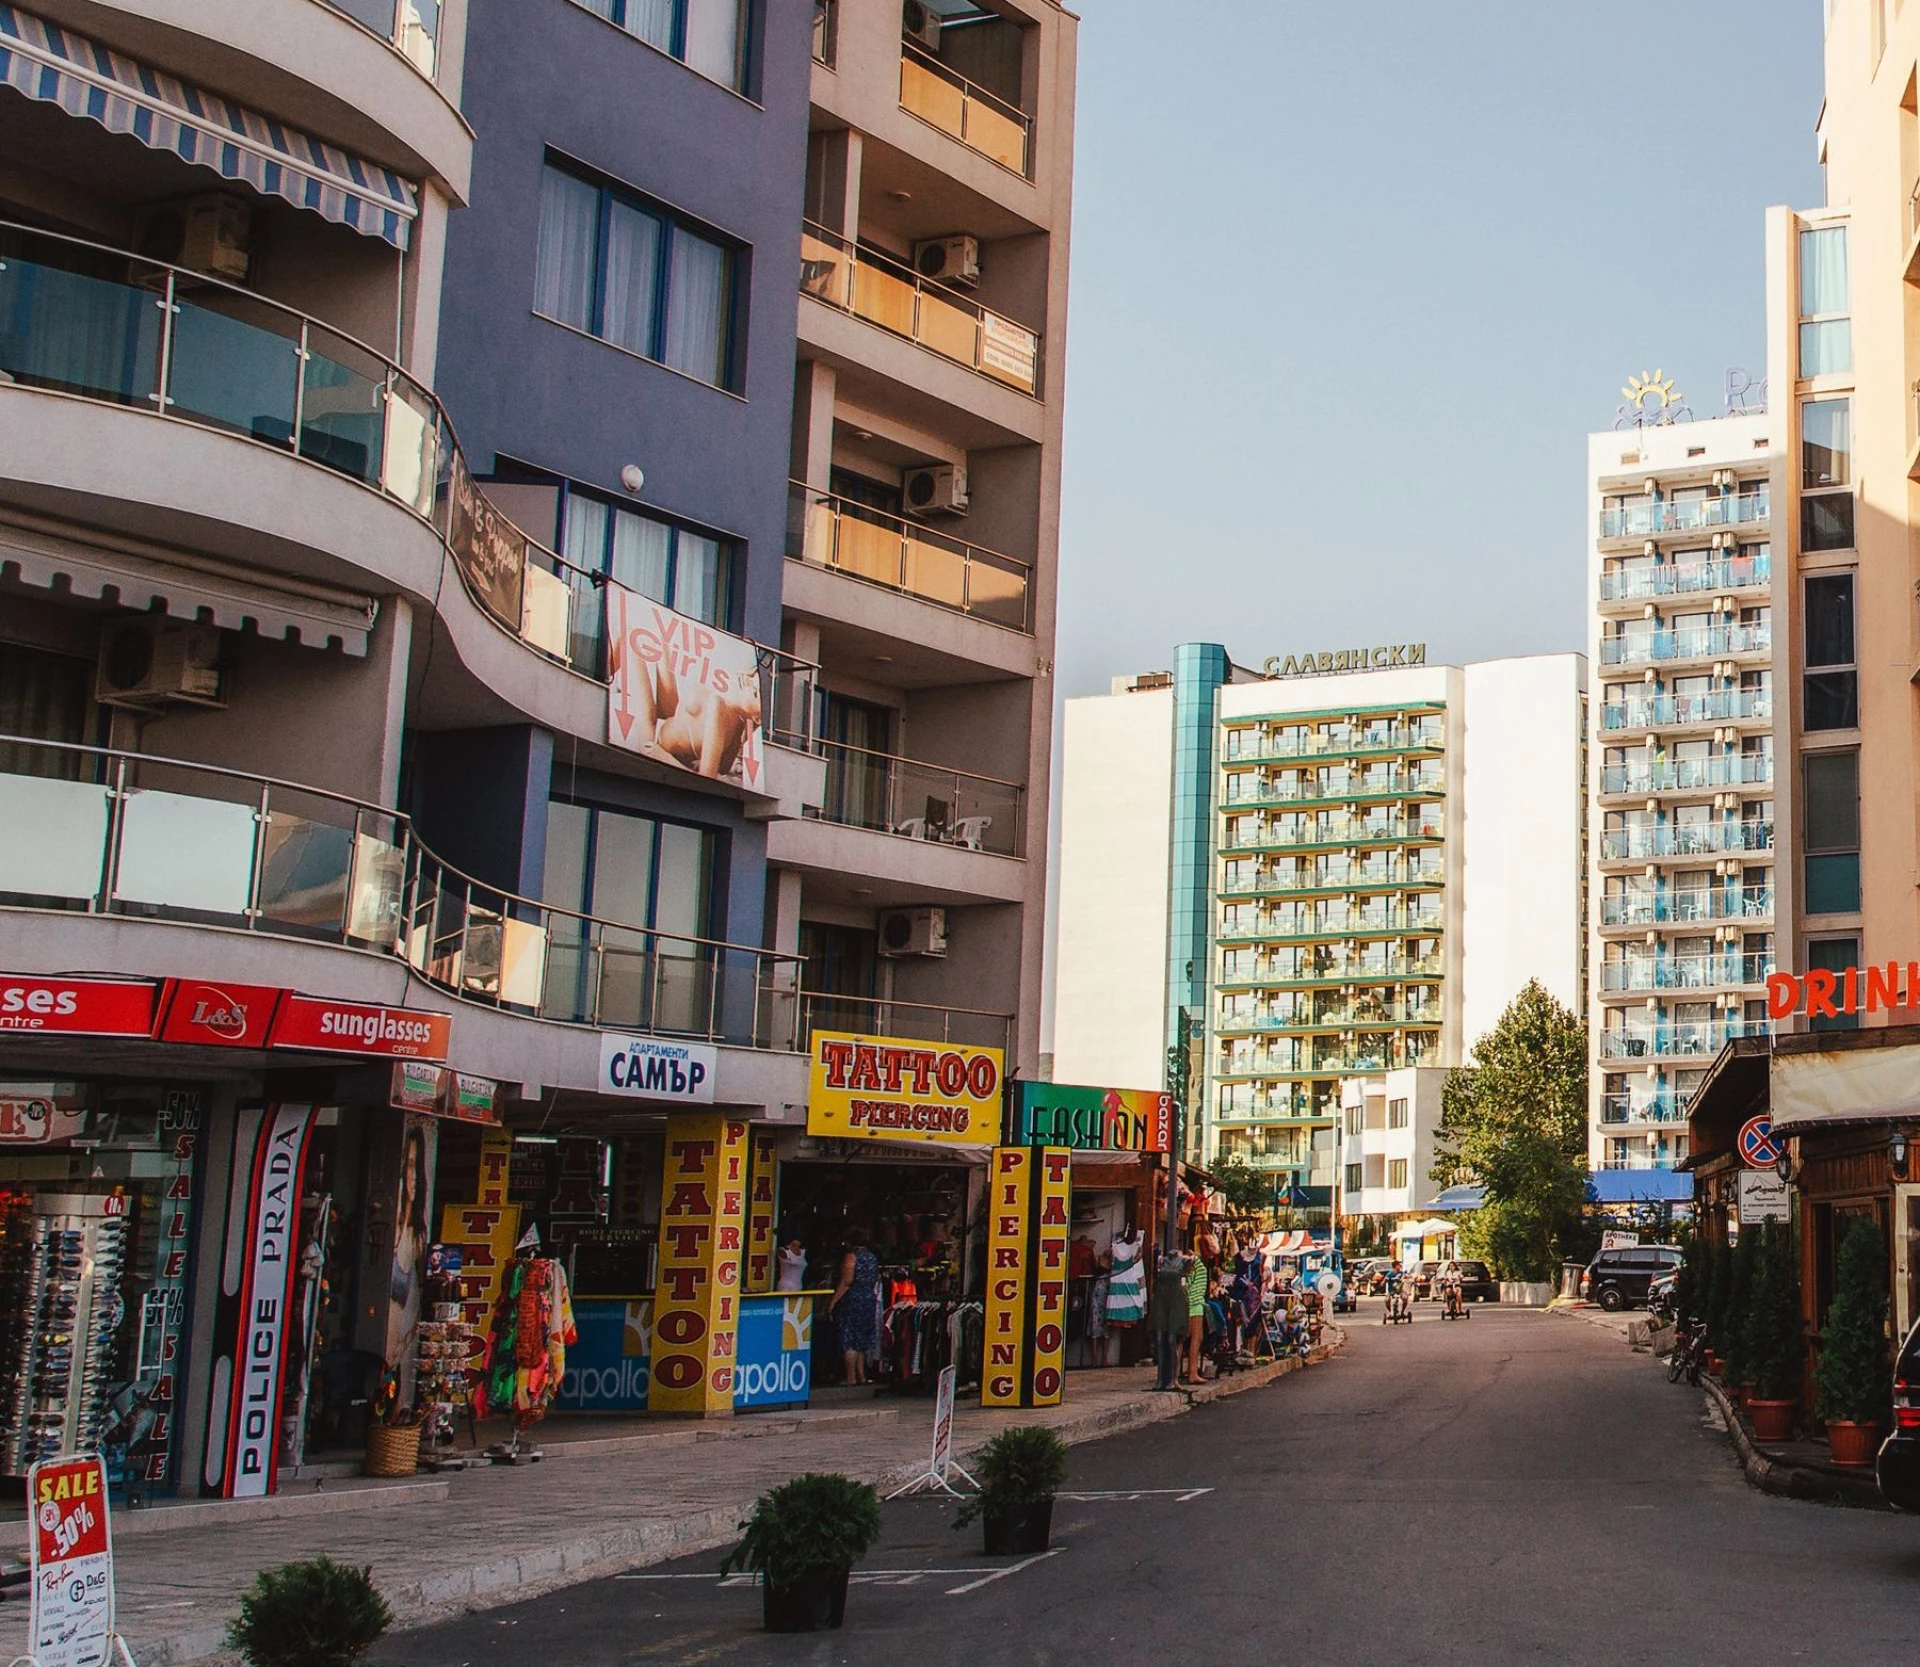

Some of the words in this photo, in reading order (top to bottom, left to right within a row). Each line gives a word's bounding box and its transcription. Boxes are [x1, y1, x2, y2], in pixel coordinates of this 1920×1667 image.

[652, 607, 715, 657] VIP
[629, 628, 729, 693] Girls
[1263, 643, 1426, 676] СЛАВЯНСКИ
[2, 988, 77, 1015] ses
[190, 1001, 248, 1027] L&S
[320, 1009, 431, 1045] sunglasses
[392, 1045, 419, 1056] centre
[629, 1042, 689, 1060] АПАРТАМЕНТИ
[610, 1052, 706, 1094] САМЪР
[821, 1039, 998, 1101] TATTOO
[851, 1099, 970, 1134] PIERCING
[1158, 1095, 1171, 1151] bazar
[163, 1134, 197, 1278] SALE
[711, 1122, 746, 1393] PIERCING
[1605, 1232, 1637, 1241] APOTHEKE
[654, 1140, 716, 1390] TATTOO
[990, 1152, 1024, 1398] PIERCING
[1035, 1153, 1070, 1398] TATTOO
[242, 1299, 278, 1476] POLICE
[262, 1126, 299, 1263] PRADA
[561, 1359, 649, 1408] apollo
[734, 1353, 806, 1403] apollo
[39, 1471, 98, 1503] SALE
[51, 1502, 95, 1557] -50%
[86, 1571, 106, 1587] D&G
